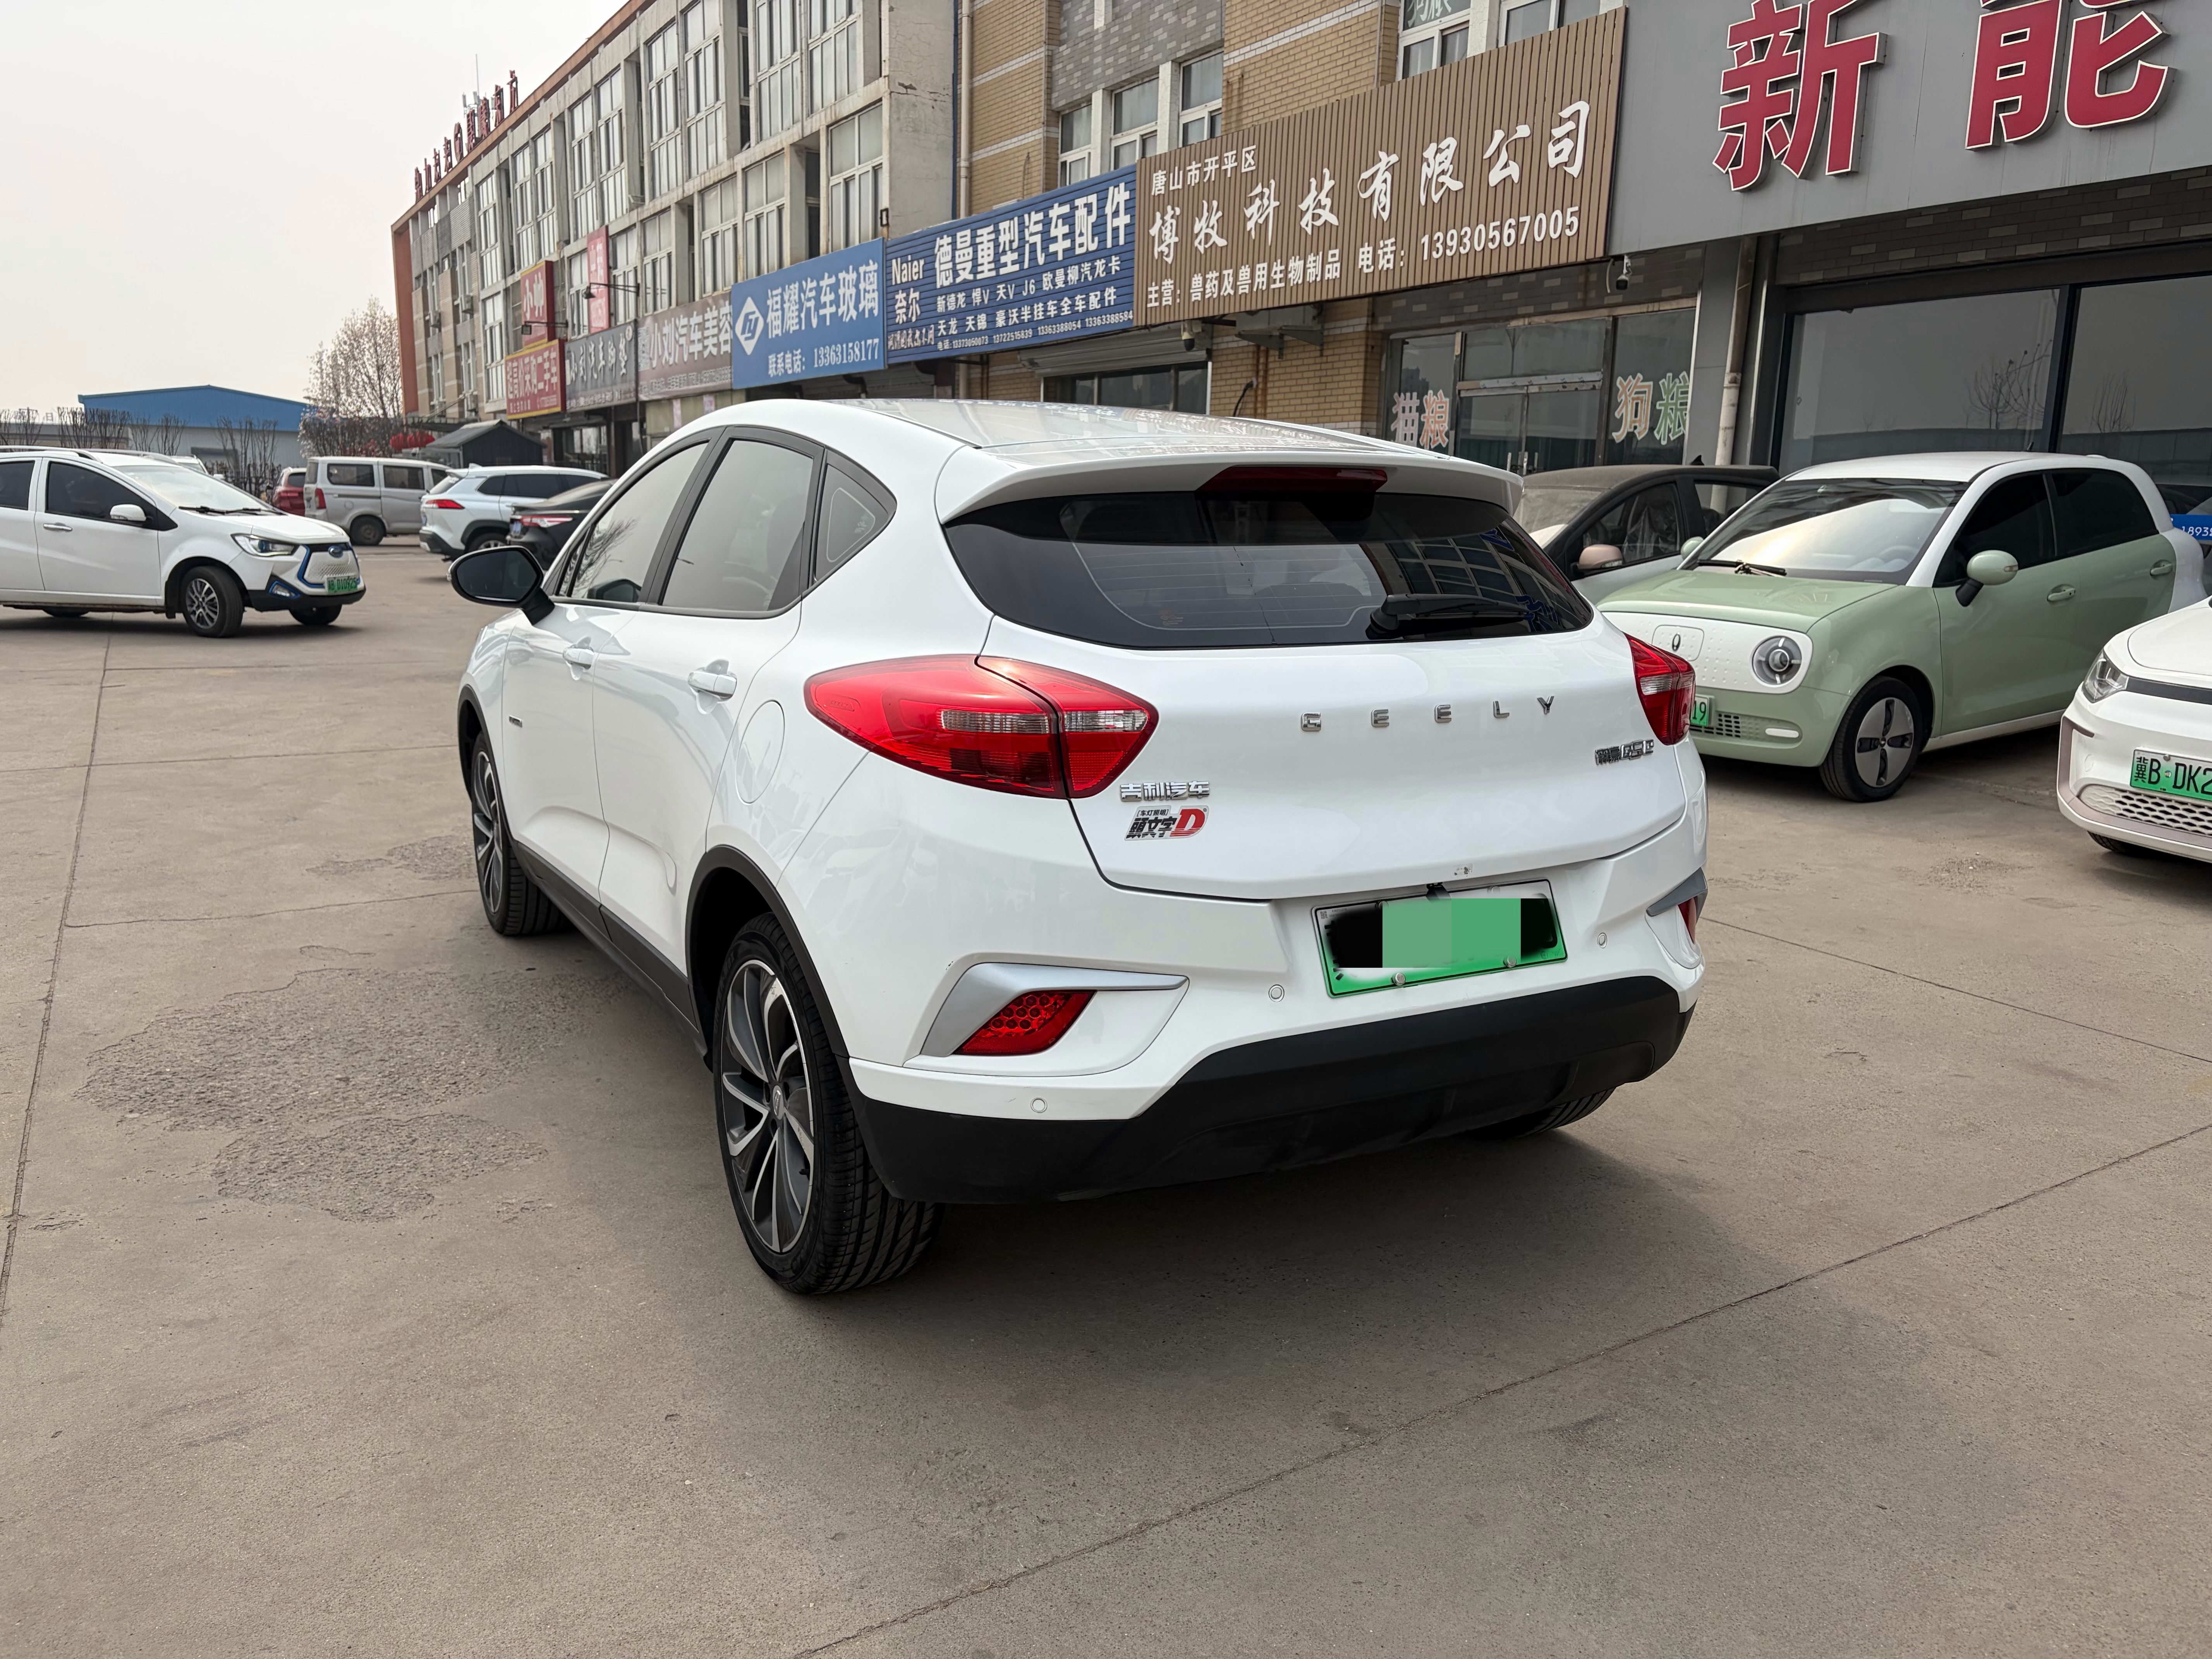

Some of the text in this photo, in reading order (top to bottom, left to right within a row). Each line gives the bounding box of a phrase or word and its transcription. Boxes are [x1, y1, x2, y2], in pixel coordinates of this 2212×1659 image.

[1149, 100, 1590, 264] 博牧科技有限公司
[1151, 145, 1256, 196] 唐山市开平区
[934, 182, 1130, 289] 德曼重型汽车配件
[1147, 206, 1580, 307] 主营： 兽药及兽用生物制品 电话： 13930567005
[892, 255, 925, 285] Naier
[1022, 279, 1036, 296] J6
[1042, 255, 1121, 291] 欧曼柳汽龙卡
[767, 259, 878, 339] 福耀汽车玻璃
[895, 288, 921, 324] 奈尔
[938, 318, 958, 337] 天龙
[995, 286, 1116, 328] 豪沃半挂车全车配件
[1085, 310, 1133, 328] 13363388584
[650, 302, 732, 368] 小刘汽车美容
[768, 338, 879, 378] 联系电话： 13363158177
[1391, 389, 1449, 450] 猫粮
[1612, 371, 1689, 445] 狗粮
[1301, 696, 1554, 731] GEELY
[1120, 781, 1210, 802] 吉利汽车
